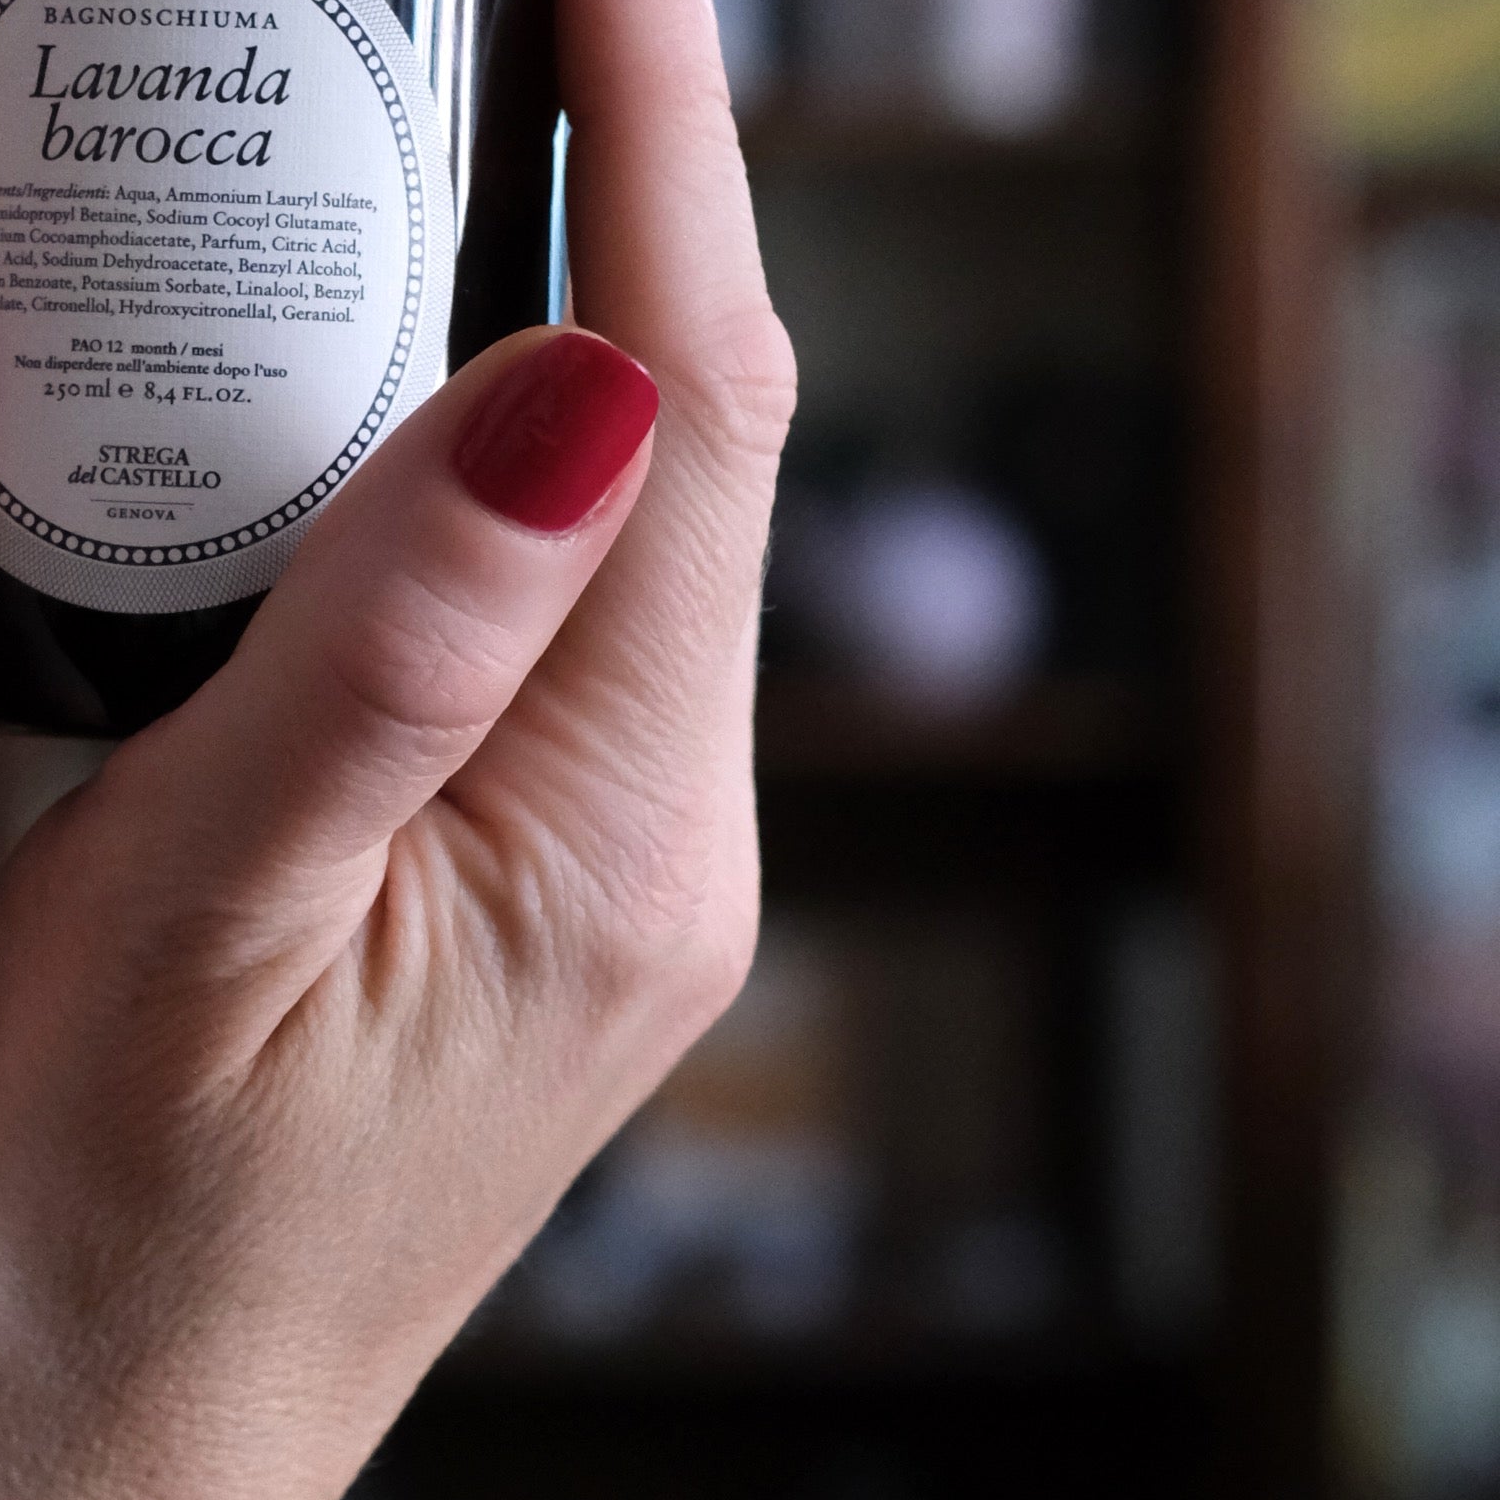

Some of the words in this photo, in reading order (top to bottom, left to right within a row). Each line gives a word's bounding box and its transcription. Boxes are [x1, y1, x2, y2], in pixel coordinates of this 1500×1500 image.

[44, 7, 279, 30] BAGNOSCHIUMA
[29, 44, 291, 105] Lavanda
[41, 102, 272, 167] barocca
[115, 185, 161, 204] Aqua,
[166, 187, 262, 205] Ammonium
[267, 191, 318, 210] Lauryl
[322, 193, 378, 212] Sulfate,
[80, 207, 142, 226] Betaine,
[147, 208, 207, 226] Sodium
[213, 211, 270, 231] Cocoyl
[275, 213, 362, 234] Glutamate,
[30, 228, 196, 251] Cocoamphodiacetate,
[201, 234, 267, 253] Parfum,
[272, 237, 317, 253] Citric
[322, 238, 362, 258] Acid,
[3, 251, 38, 269] Acid,
[42, 252, 98, 268] Sodium
[103, 254, 233, 274] Dehydroacetate,
[238, 258, 291, 277] Benzyl
[297, 260, 362, 280] Alcohol,
[9, 273, 77, 292] Benzoate,
[81, 276, 160, 292] Potassium
[165, 278, 231, 297] Sorbate,
[236, 281, 309, 300] Linalool,
[315, 284, 364, 303] Benzyl
[32, 297, 115, 316] Citronellol,
[119, 300, 277, 322] Hydroxycitronellal,
[282, 305, 354, 323] Geraniol.
[71, 339, 102, 352] PAO
[107, 340, 122, 353] 12
[131, 340, 177, 356] month
[191, 344, 224, 357] mesi
[14, 354, 42, 370] Non
[45, 356, 112, 373] disperdere
[214, 362, 250, 378] dopo
[44, 382, 80, 400] 250
[86, 378, 111, 398] ml
[144, 381, 176, 405] 8,4
[98, 445, 190, 467] STREGA
[68, 466, 98, 485] del
[100, 467, 221, 489] CASTELLO
[107, 508, 176, 521] GENOVA
